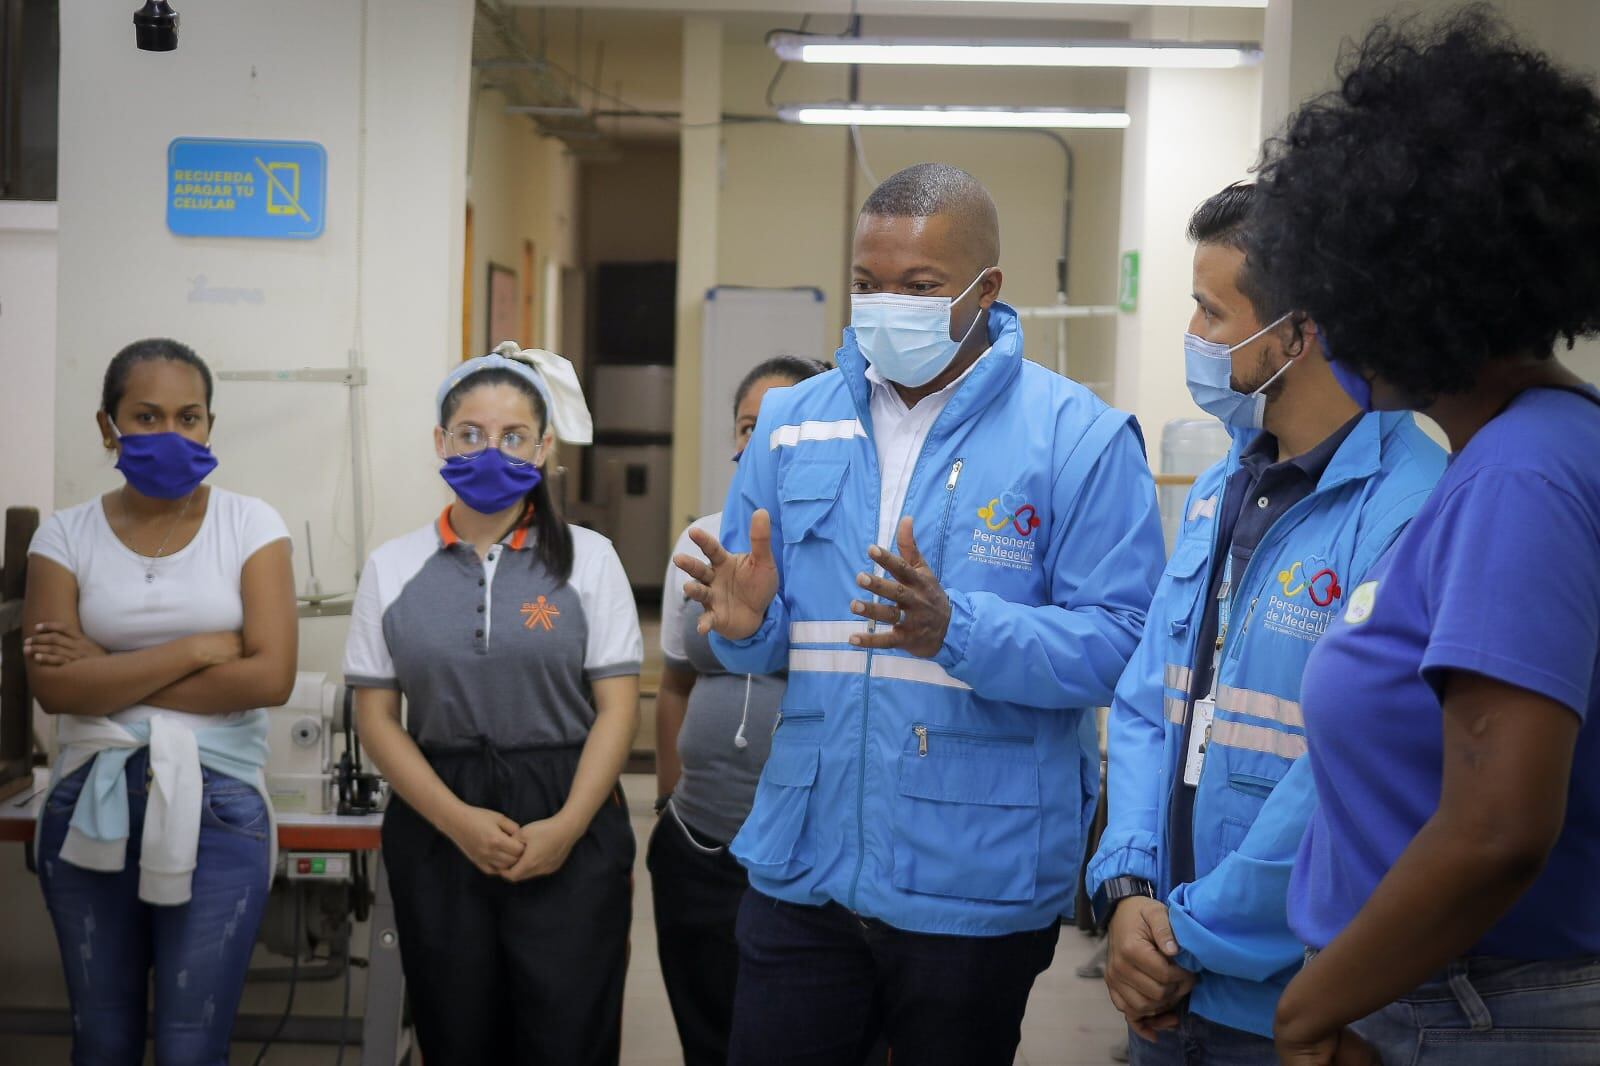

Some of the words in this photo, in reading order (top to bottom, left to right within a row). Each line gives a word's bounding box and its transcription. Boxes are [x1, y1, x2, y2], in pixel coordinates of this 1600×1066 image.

[175, 170, 254, 183] RECUERDA
[175, 184, 233, 196] APAGAR
[236, 186, 255, 197] TU
[174, 197, 236, 209] CELULAR
[971, 542, 986, 554] de
[1266, 608, 1279, 621] de
